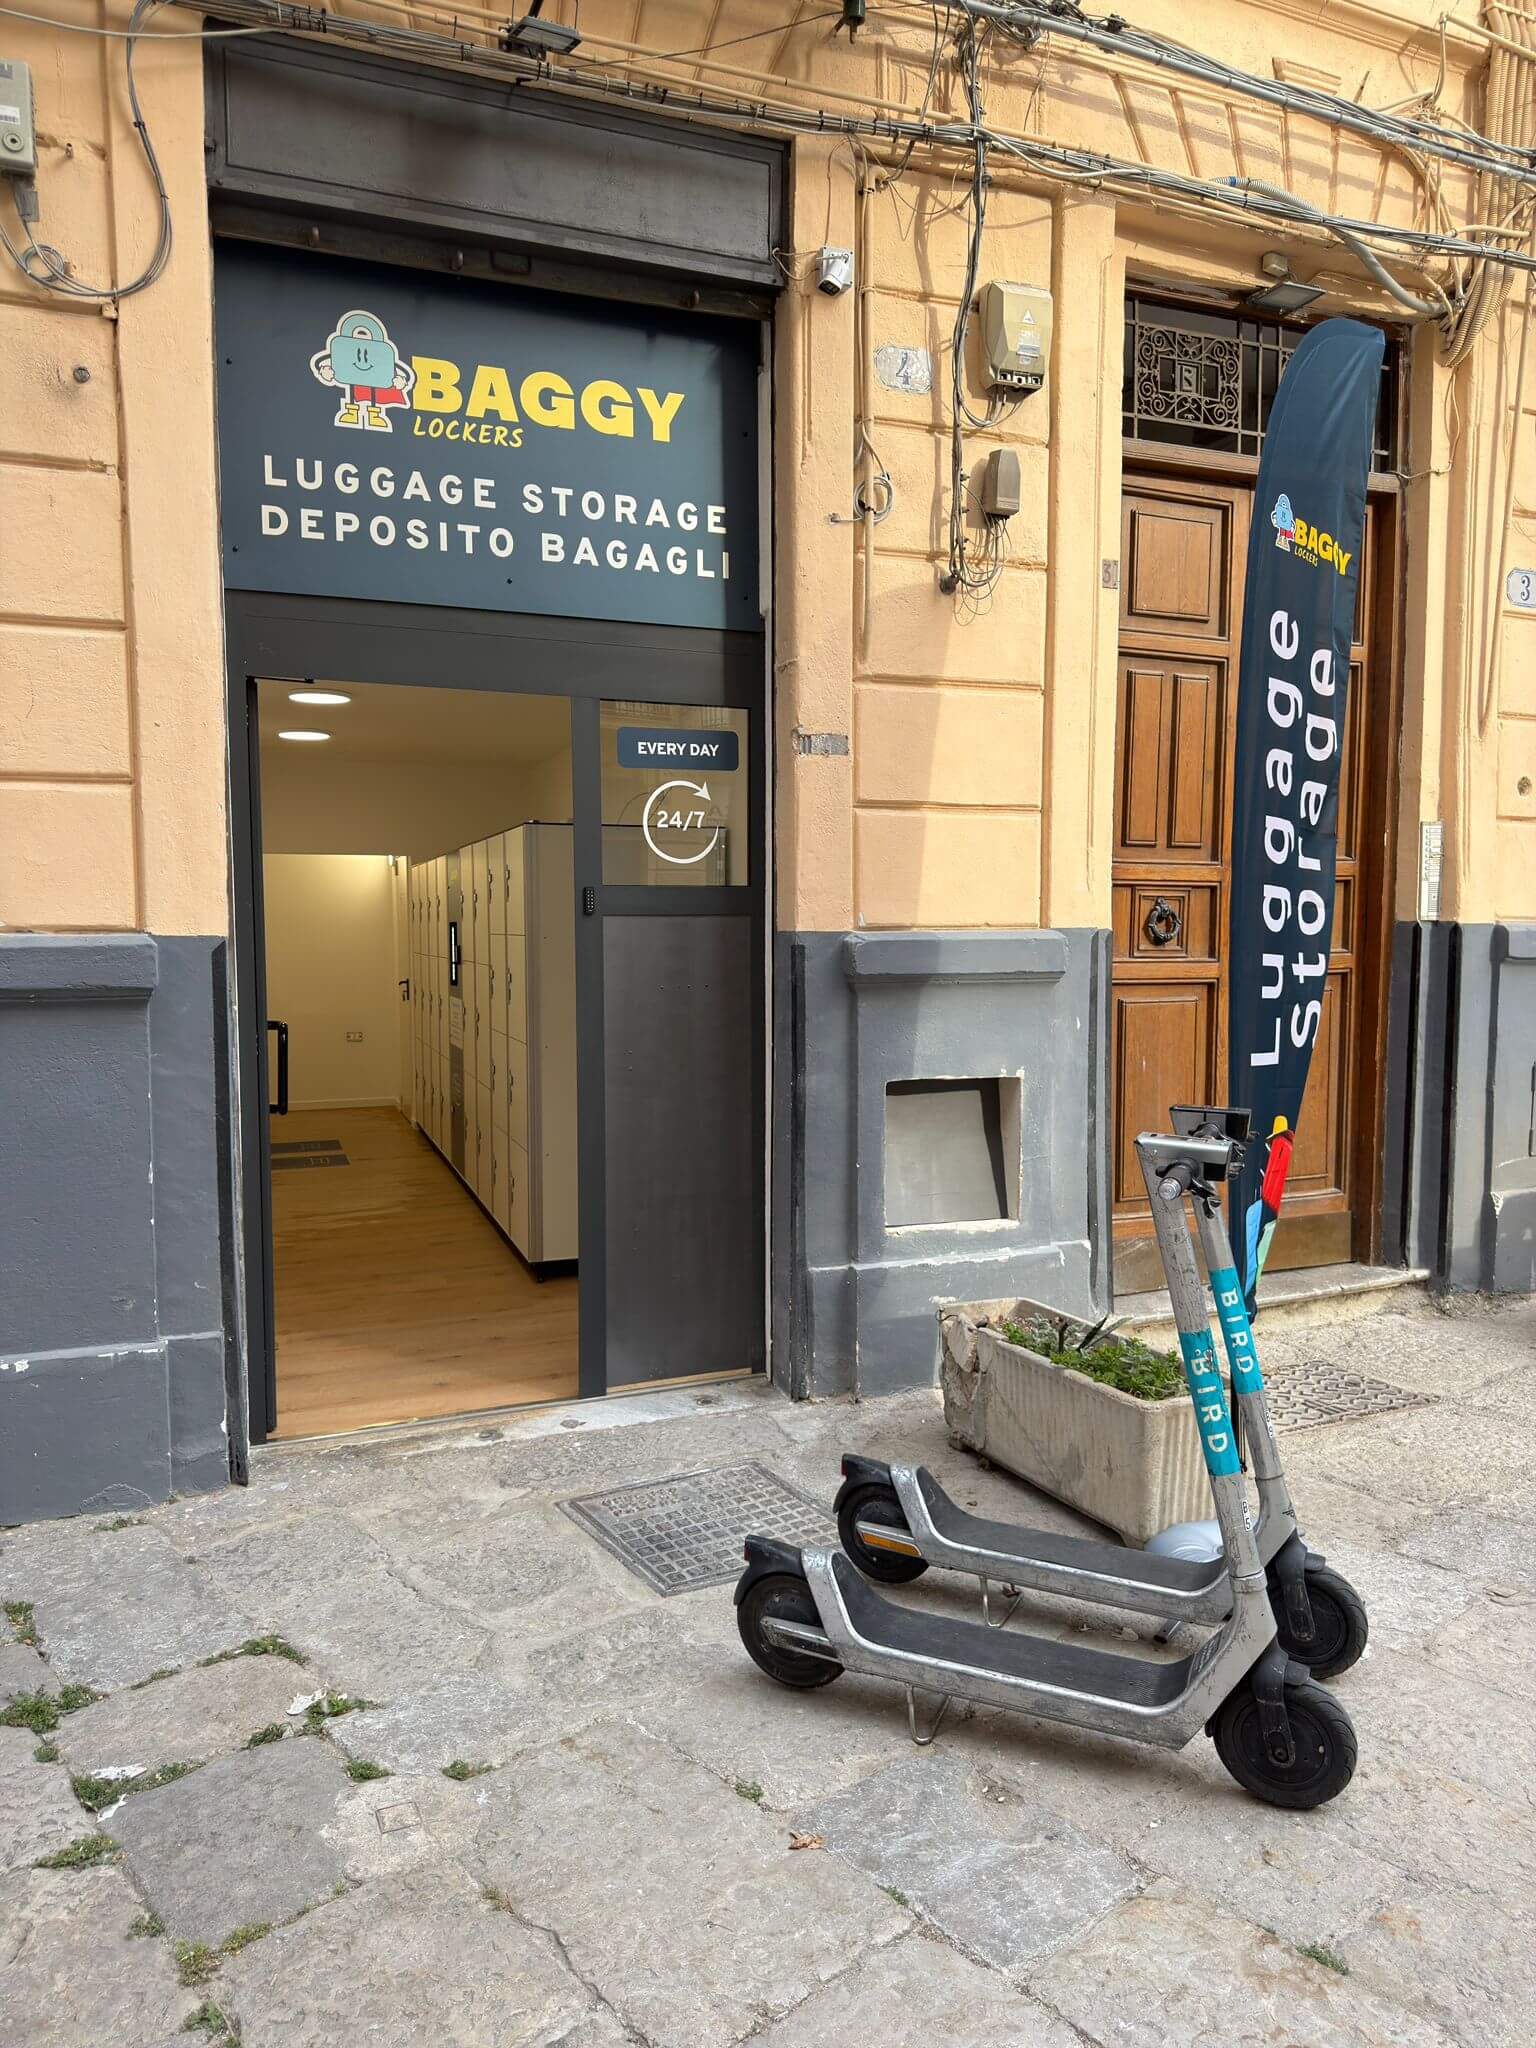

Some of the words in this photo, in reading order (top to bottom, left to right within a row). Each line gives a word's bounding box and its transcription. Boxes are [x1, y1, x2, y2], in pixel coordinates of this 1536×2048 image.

[411, 356, 685, 442] BAGGY
[896, 351, 911, 385] 4
[414, 416, 524, 447] LOCKERS
[263, 455, 496, 509] LUGGAGE
[522, 483, 727, 535] STORAGE
[261, 504, 513, 558] DEPOSITO
[541, 533, 730, 579] BAGAGLI
[1520, 575, 1530, 601] 3
[637, 741, 686, 756] EVERY
[690, 743, 719, 757] DAY
[656, 810, 705, 831] 24/7
[1251, 609, 1303, 1067] Luggage
[1290, 648, 1338, 1049] Storage
[1221, 1287, 1254, 1374] BIRD
[1191, 1355, 1229, 1453] BIRD
